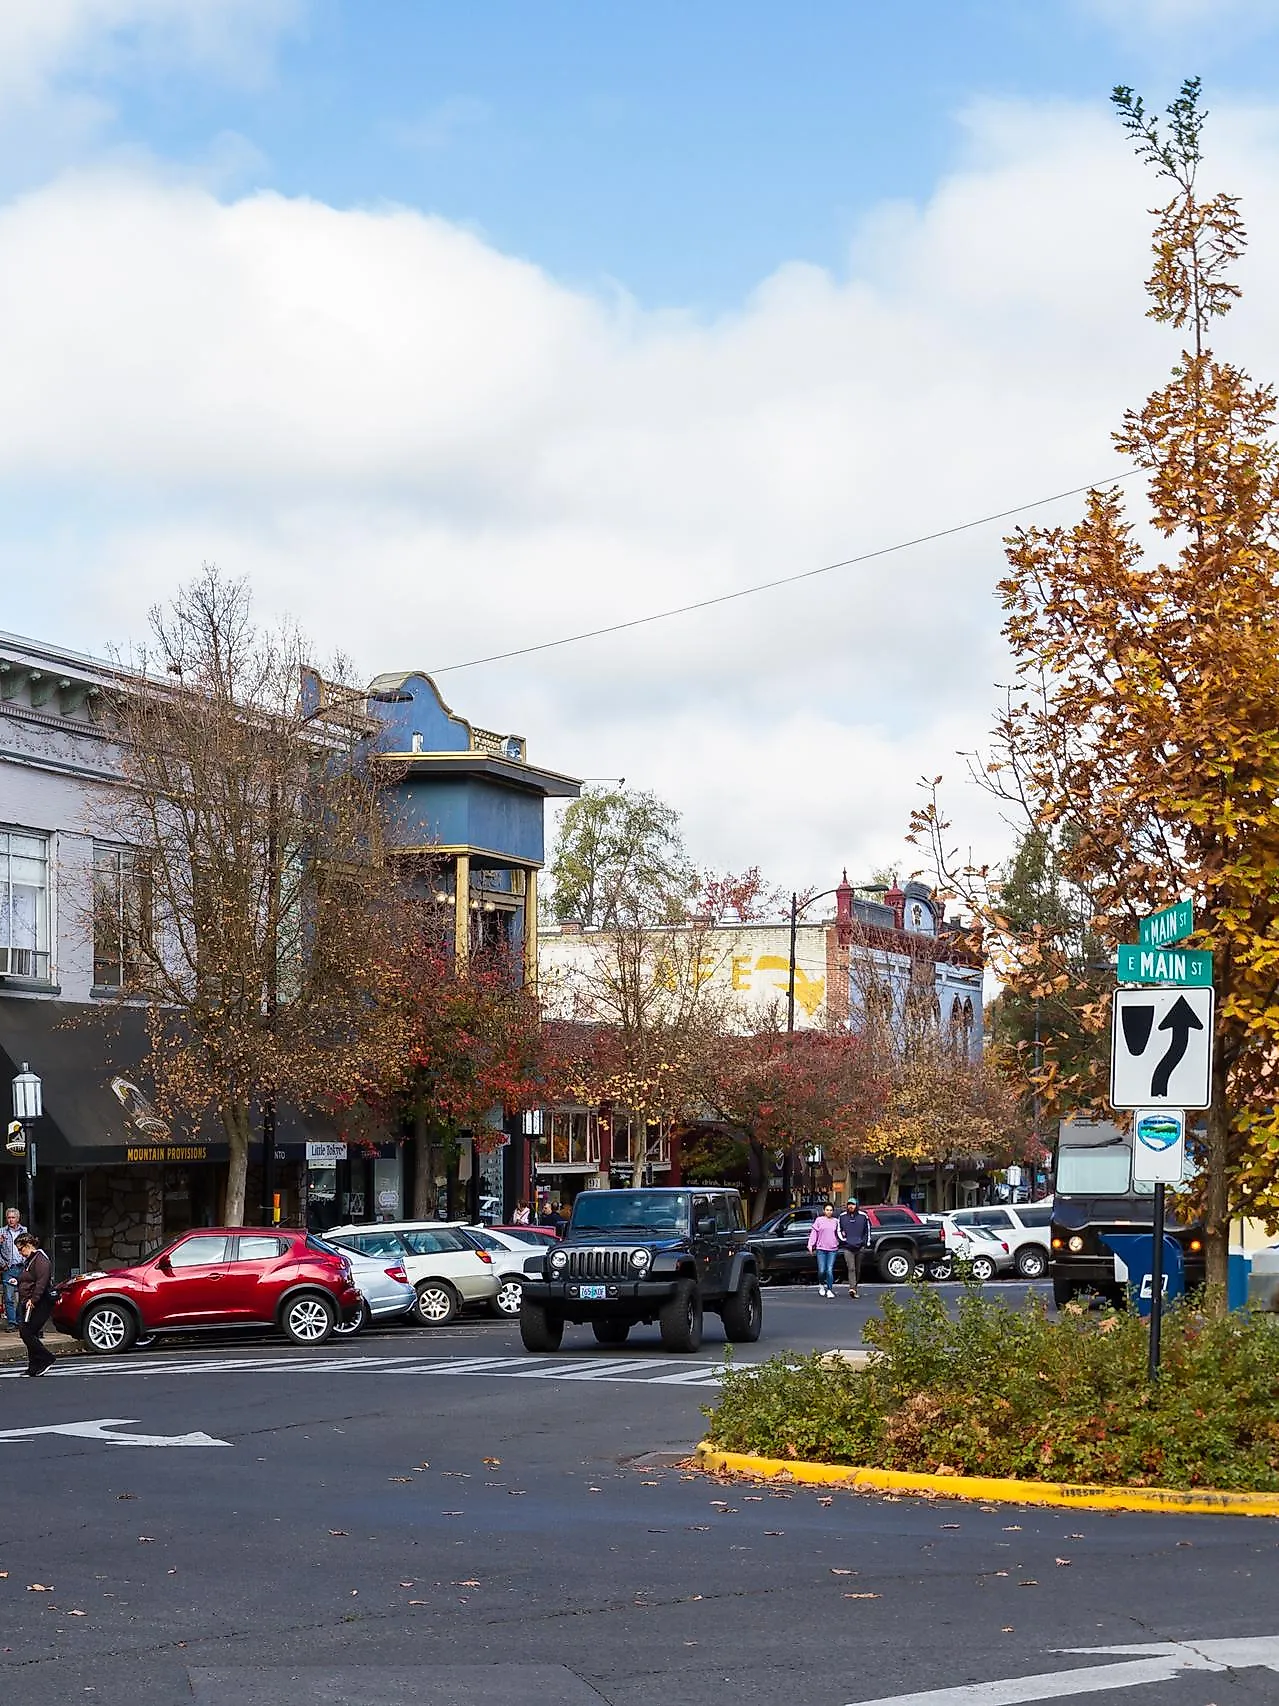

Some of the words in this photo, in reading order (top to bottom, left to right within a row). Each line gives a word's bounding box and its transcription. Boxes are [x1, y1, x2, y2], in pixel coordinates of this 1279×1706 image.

[1150, 911, 1177, 945] MAIN
[1179, 912, 1187, 928] ST
[1128, 956, 1135, 971] E
[1140, 951, 1186, 981] MAIN
[1191, 961, 1203, 976] ST
[127, 1148, 165, 1161] MOUNTAIN
[167, 1146, 207, 1160] PROVISIONS
[274, 1150, 286, 1160] NTO
[311, 1144, 325, 1156] Little
